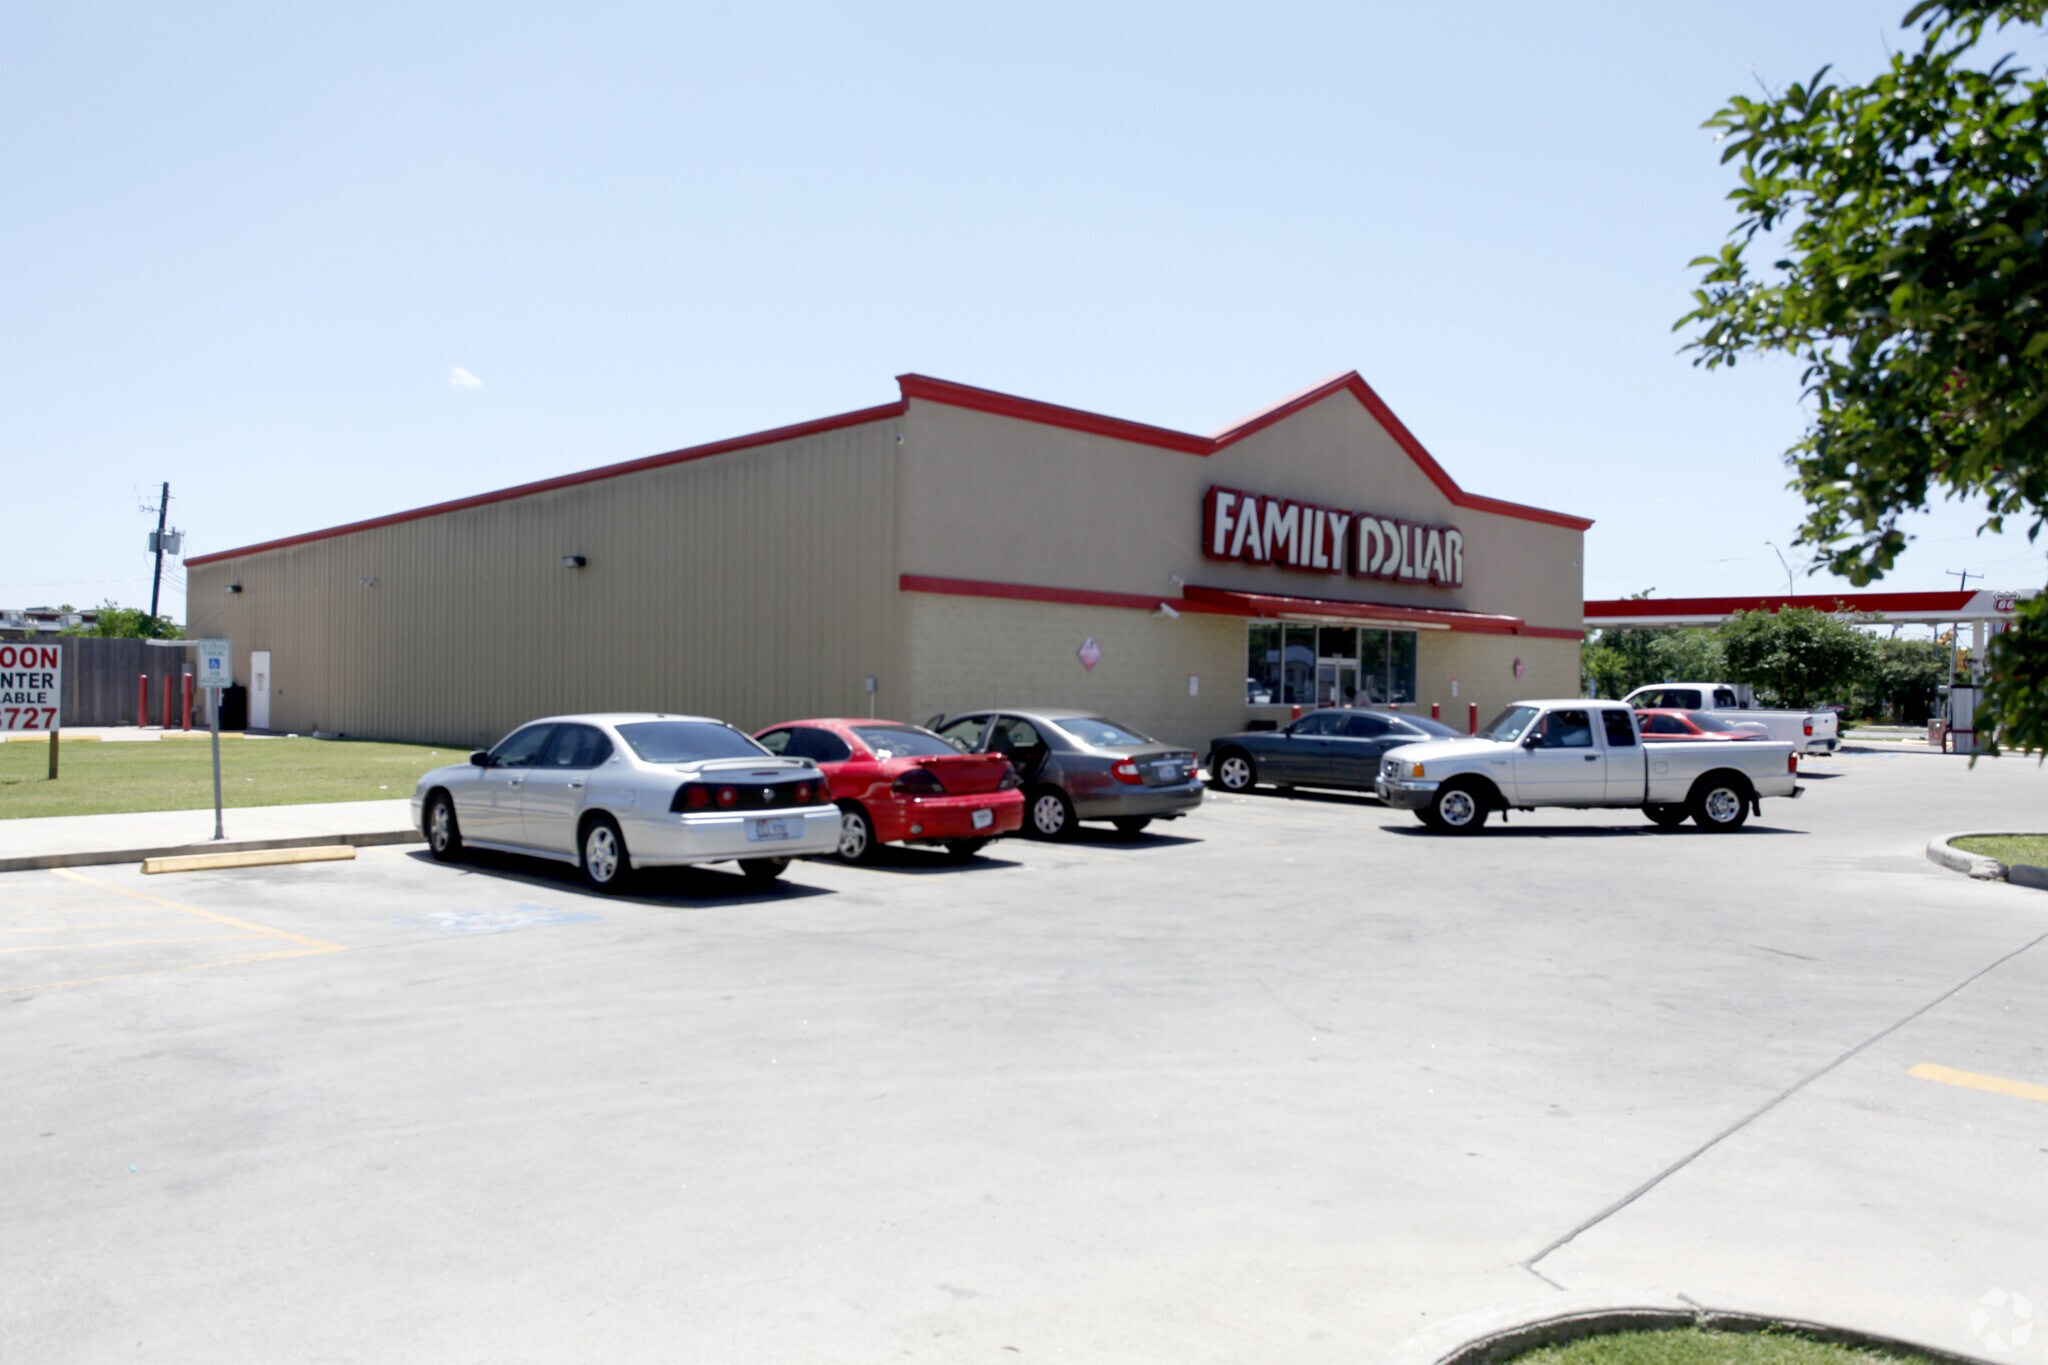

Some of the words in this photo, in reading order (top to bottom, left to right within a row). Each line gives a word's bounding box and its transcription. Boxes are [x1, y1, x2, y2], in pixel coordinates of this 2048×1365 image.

[1212, 491, 1349, 571] FAMILY
[1359, 516, 1463, 584] DOLLAR
[1998, 600, 2015, 610] 66
[0, 646, 58, 669] OON
[0, 672, 54, 689] NTER
[0, 692, 47, 704] ABLE
[0, 707, 57, 730] 727
